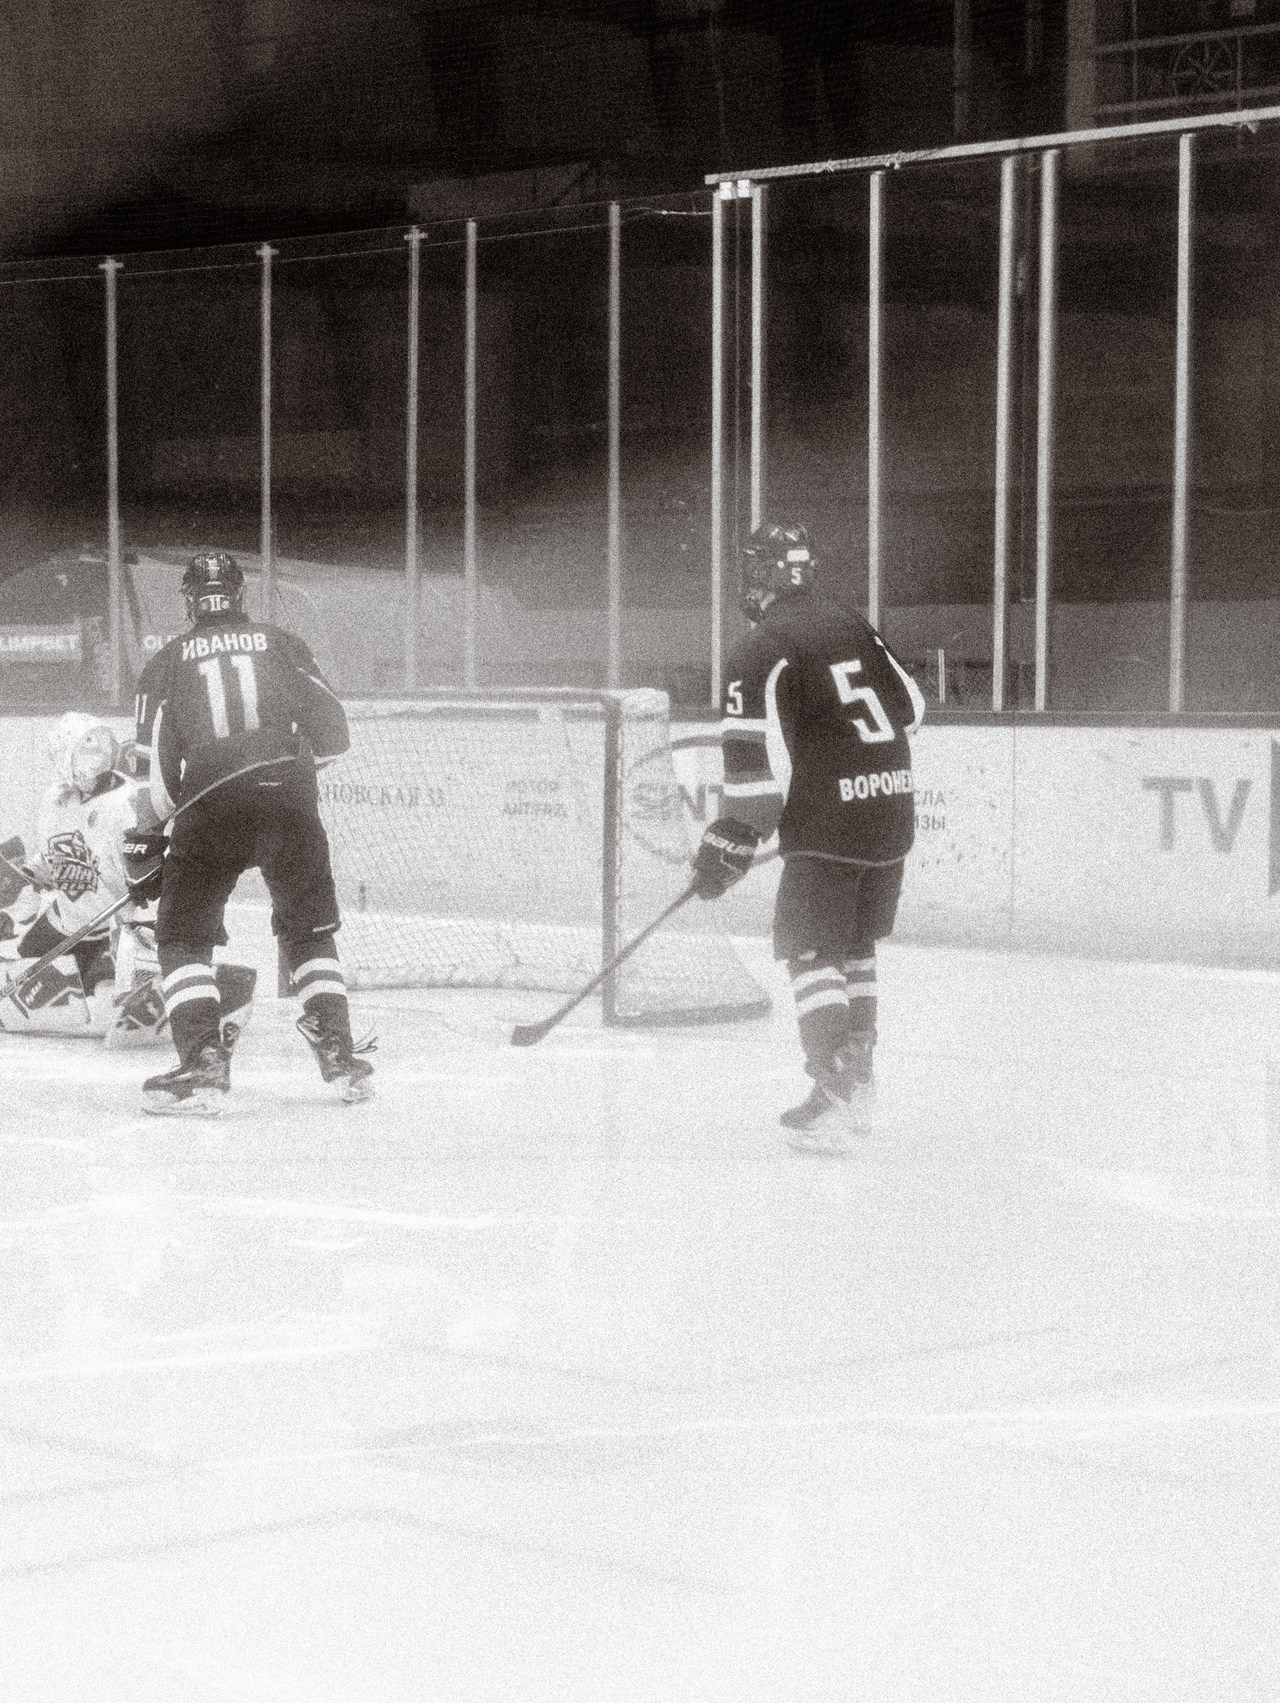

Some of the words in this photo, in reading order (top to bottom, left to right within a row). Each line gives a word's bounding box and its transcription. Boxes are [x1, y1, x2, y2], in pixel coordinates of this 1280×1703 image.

[182, 631, 267, 660] ИВАНОВ
[197, 653, 260, 741] 11
[725, 679, 744, 716] 5
[827, 658, 896, 744] 5
[1141, 776, 1252, 853] TV
